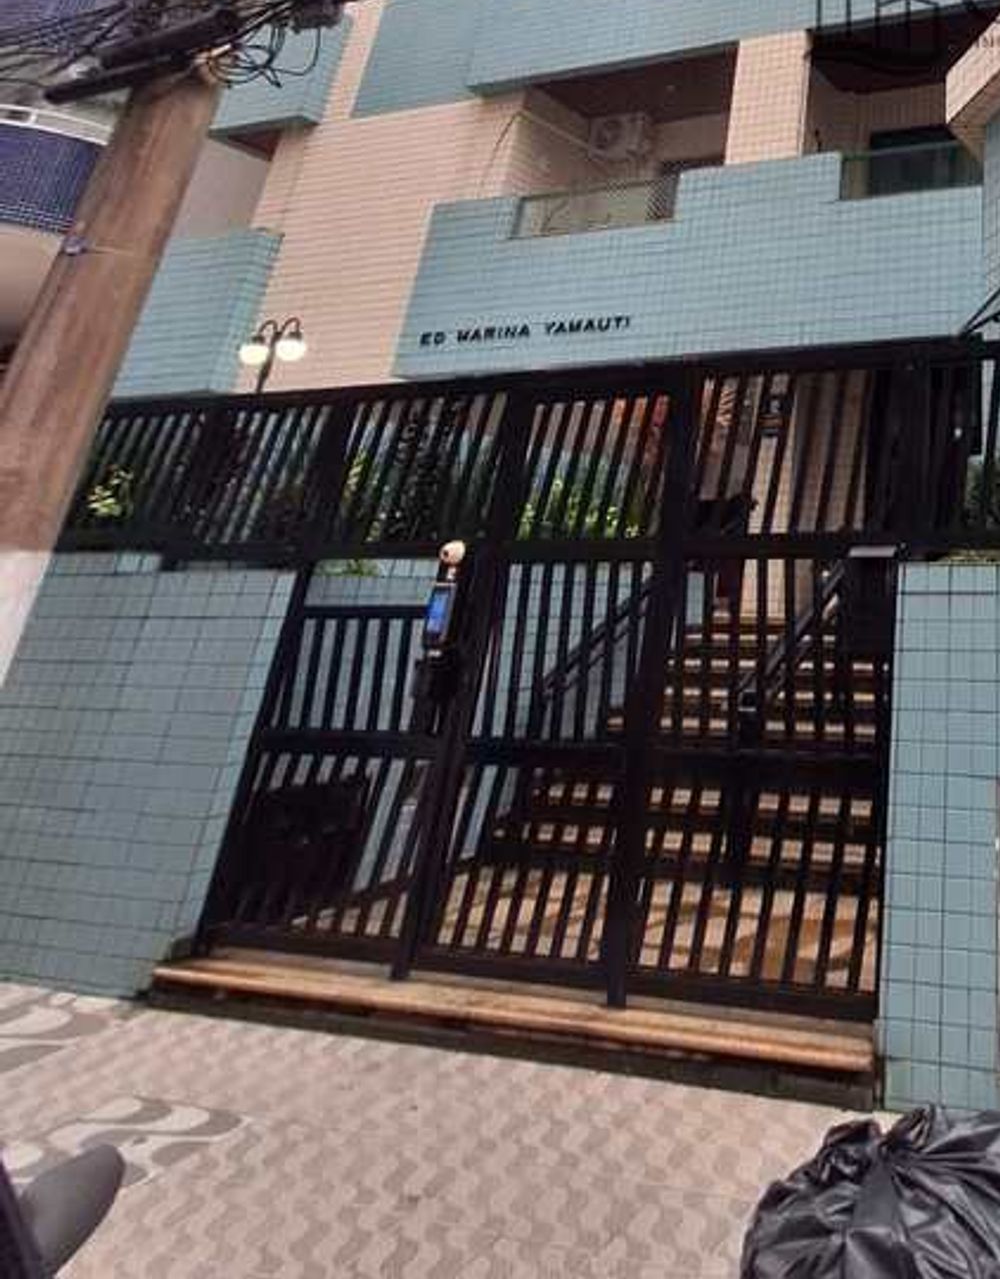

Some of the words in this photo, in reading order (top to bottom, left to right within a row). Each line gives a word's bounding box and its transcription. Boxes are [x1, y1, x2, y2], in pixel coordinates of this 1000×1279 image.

[419, 331, 446, 346] ED
[456, 324, 531, 343] MARINA
[544, 316, 631, 335] YAMAUTI
